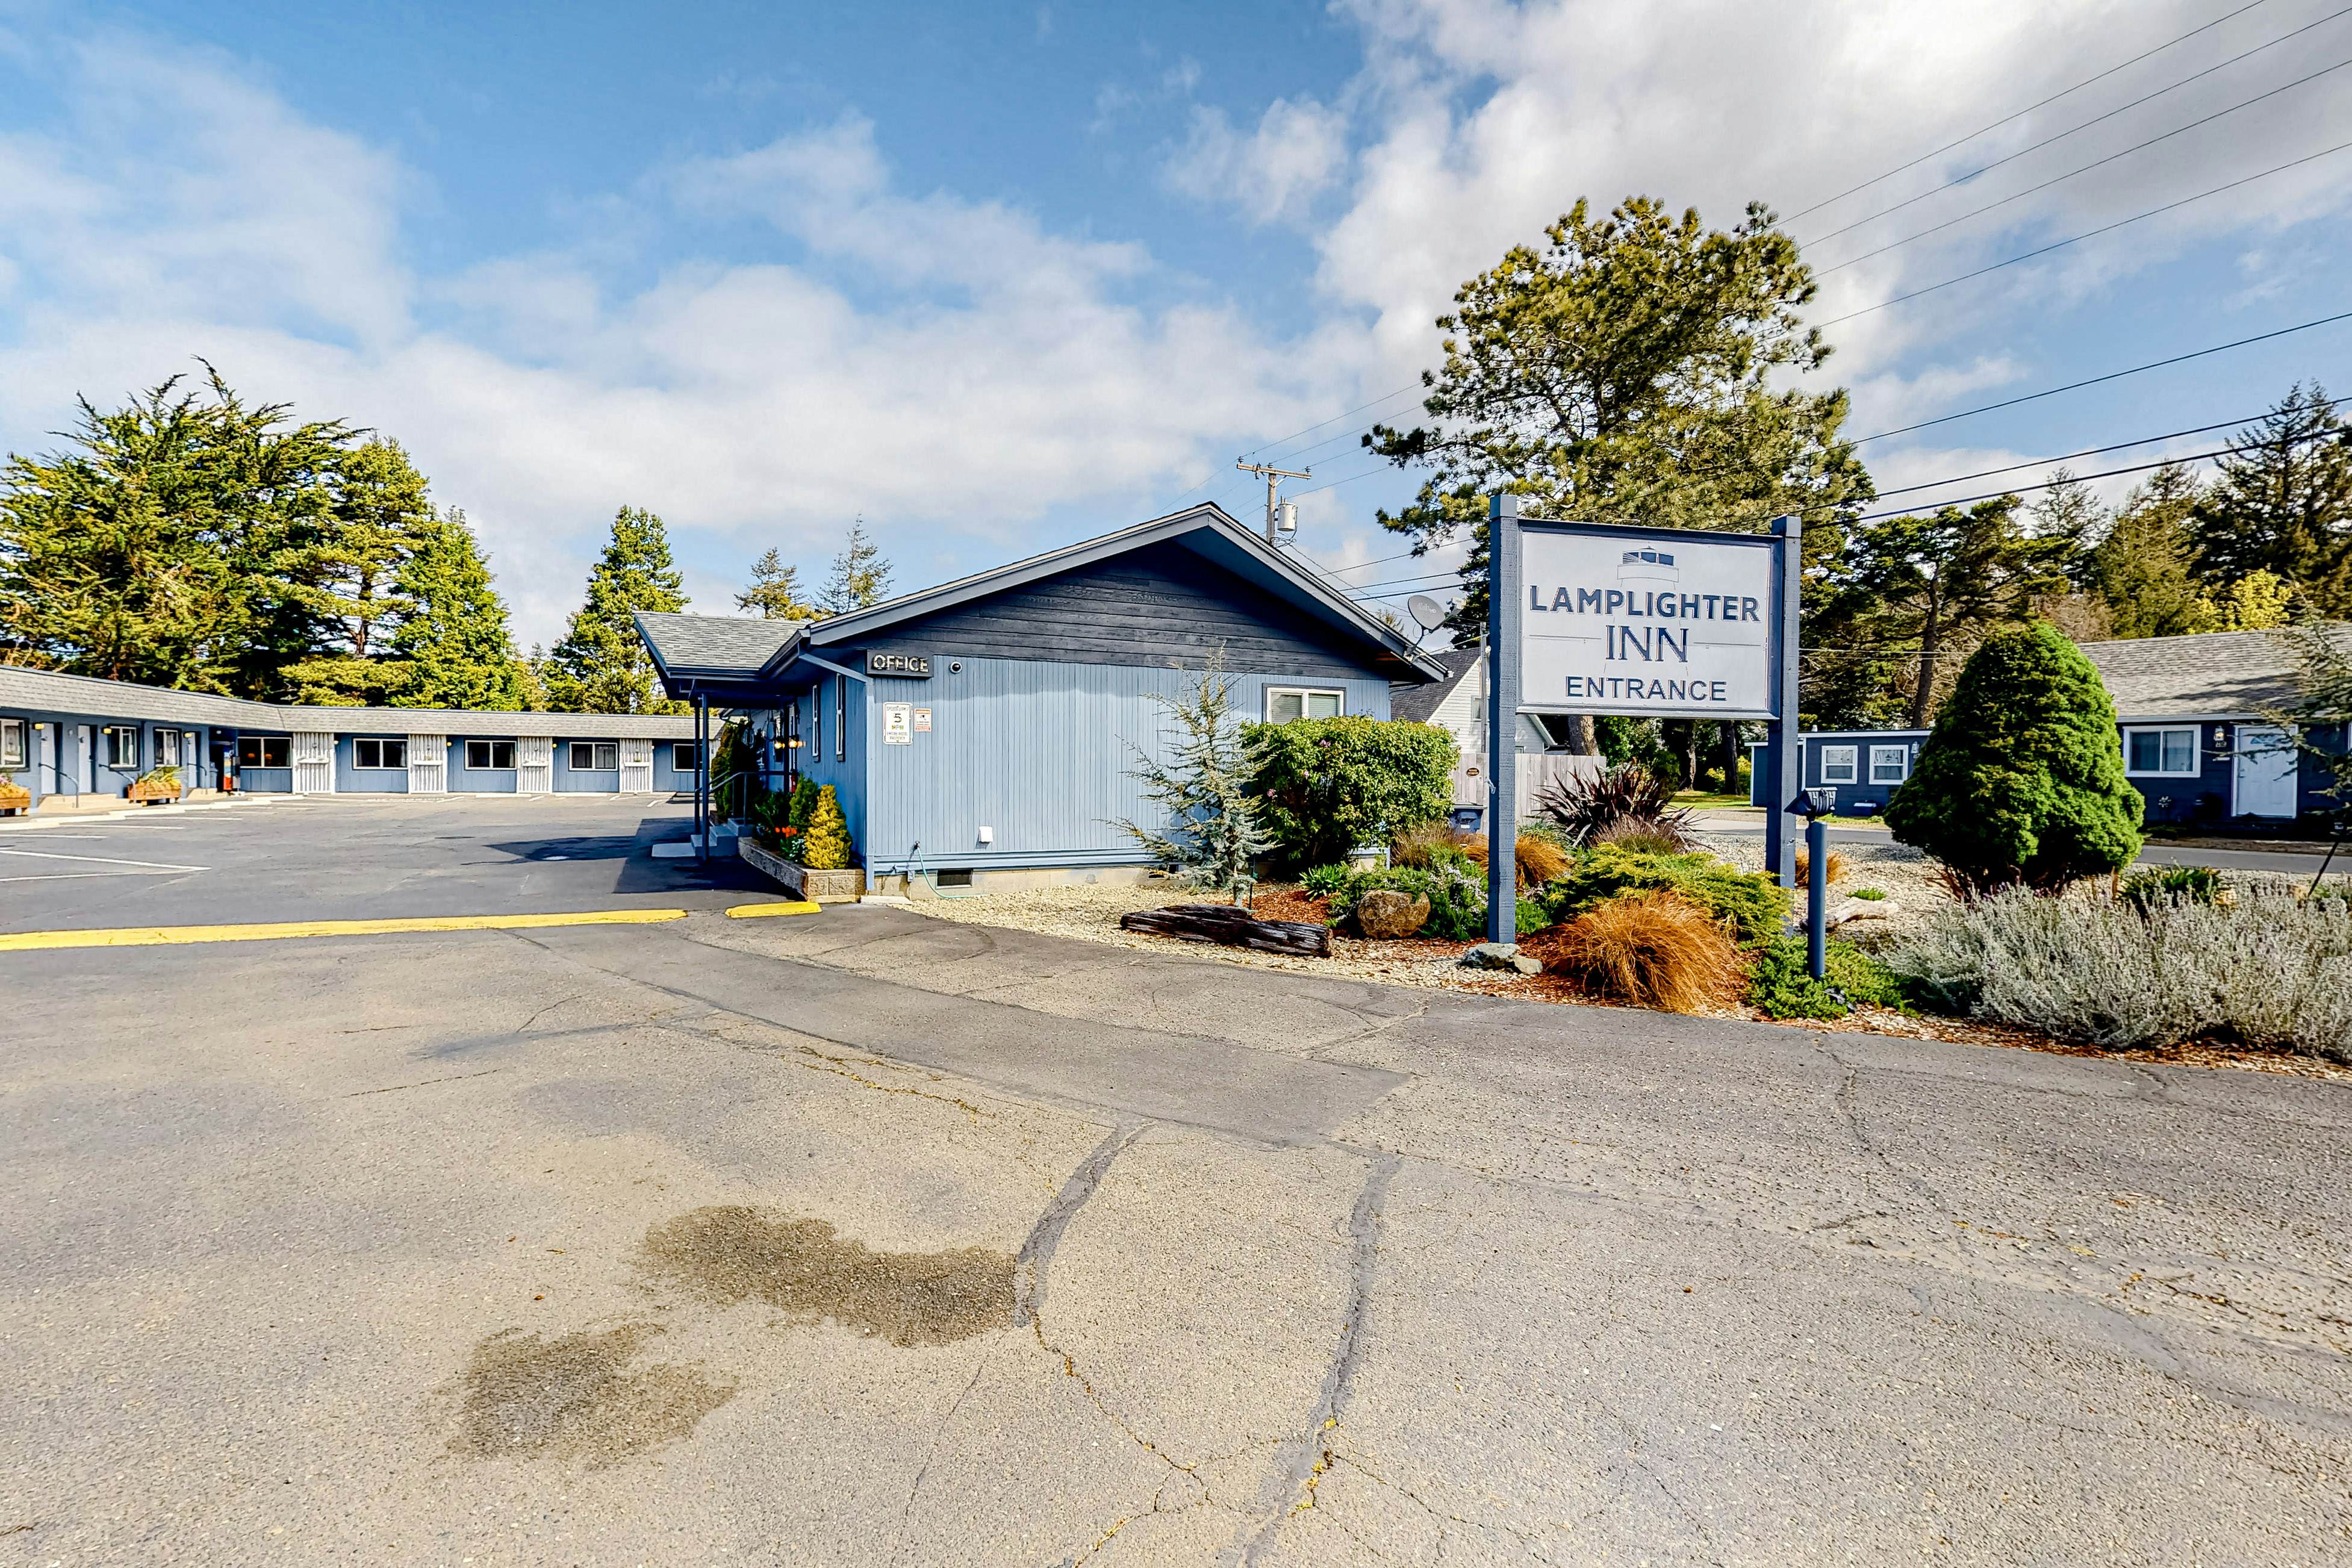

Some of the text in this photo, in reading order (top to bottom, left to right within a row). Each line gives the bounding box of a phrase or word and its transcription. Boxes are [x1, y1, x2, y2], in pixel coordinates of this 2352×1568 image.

[1529, 585, 1761, 622] LAMPLIGHTER
[1605, 624, 1690, 663] INN
[873, 654, 929, 673] OFFICE
[1565, 675, 1727, 702] ENTRANCE
[894, 713, 902, 723] 5
